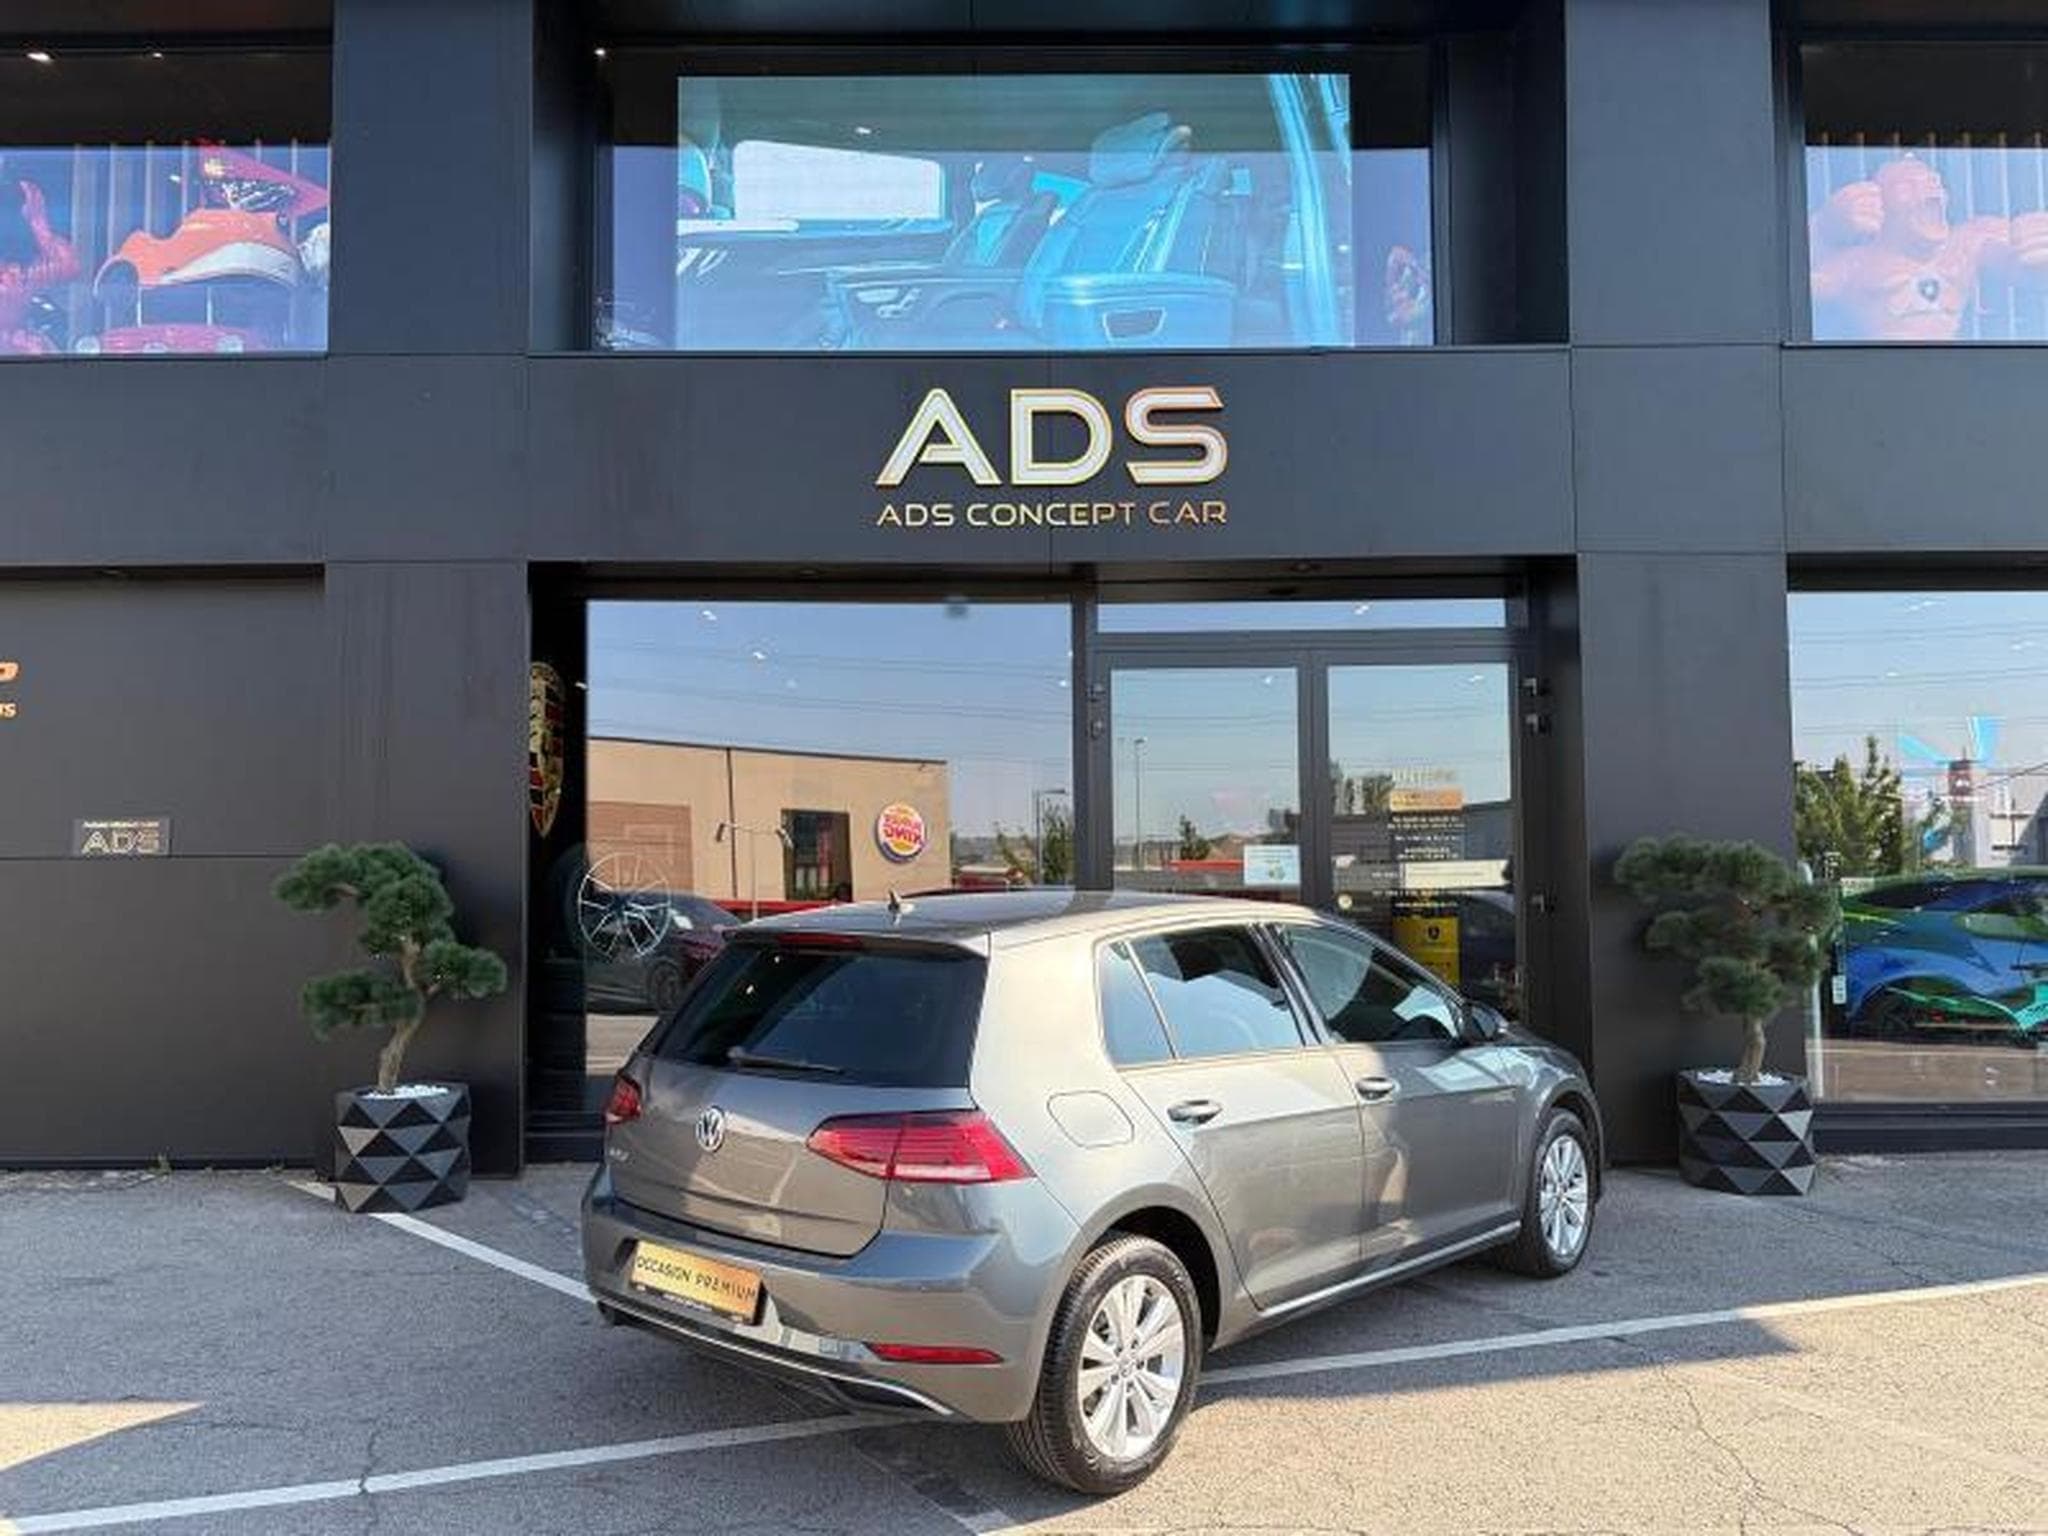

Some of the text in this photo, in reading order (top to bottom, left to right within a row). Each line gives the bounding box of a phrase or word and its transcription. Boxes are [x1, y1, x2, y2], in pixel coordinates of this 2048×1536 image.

[874, 387, 1229, 486] ADS
[877, 500, 1228, 527] ADS CONCEPT CAR
[636, 1255, 756, 1300] OCCASION PREMIUM
